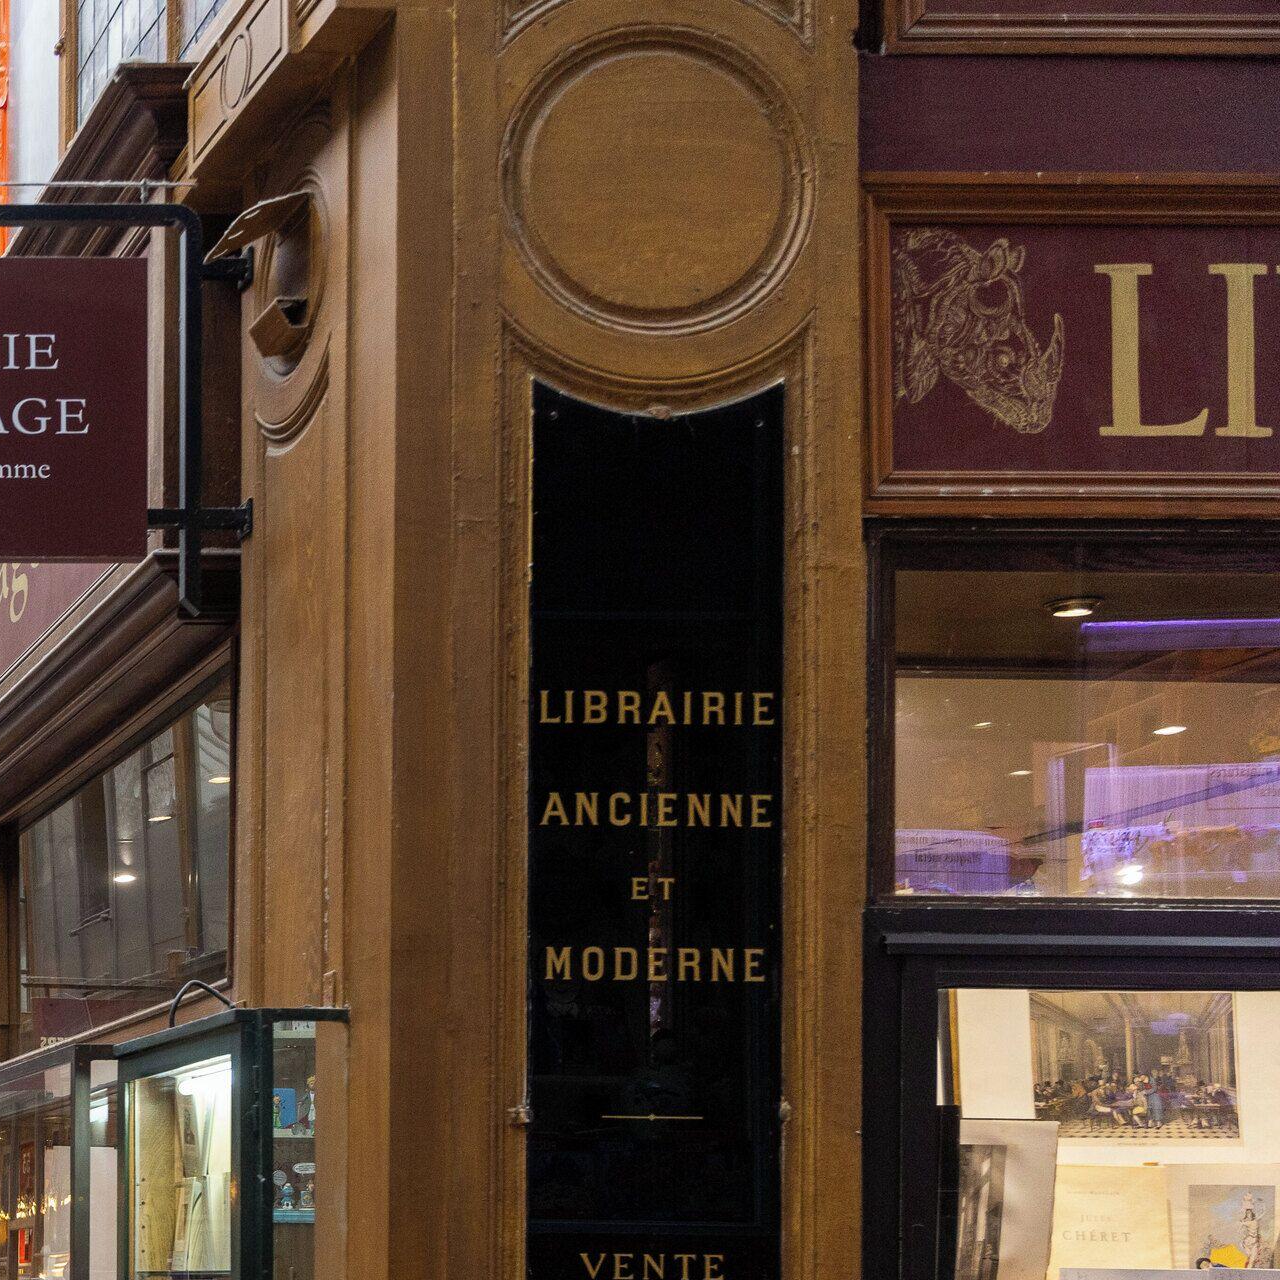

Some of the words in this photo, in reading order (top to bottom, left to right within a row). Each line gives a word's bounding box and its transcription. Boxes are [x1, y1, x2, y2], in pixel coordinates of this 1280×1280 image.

[1094, 262, 1280, 438] LI
[540, 690, 775, 726] LIBRAIRIE
[540, 791, 772, 828] ANCIENNE
[631, 877, 675, 901] ET
[545, 945, 765, 982] MODERNE
